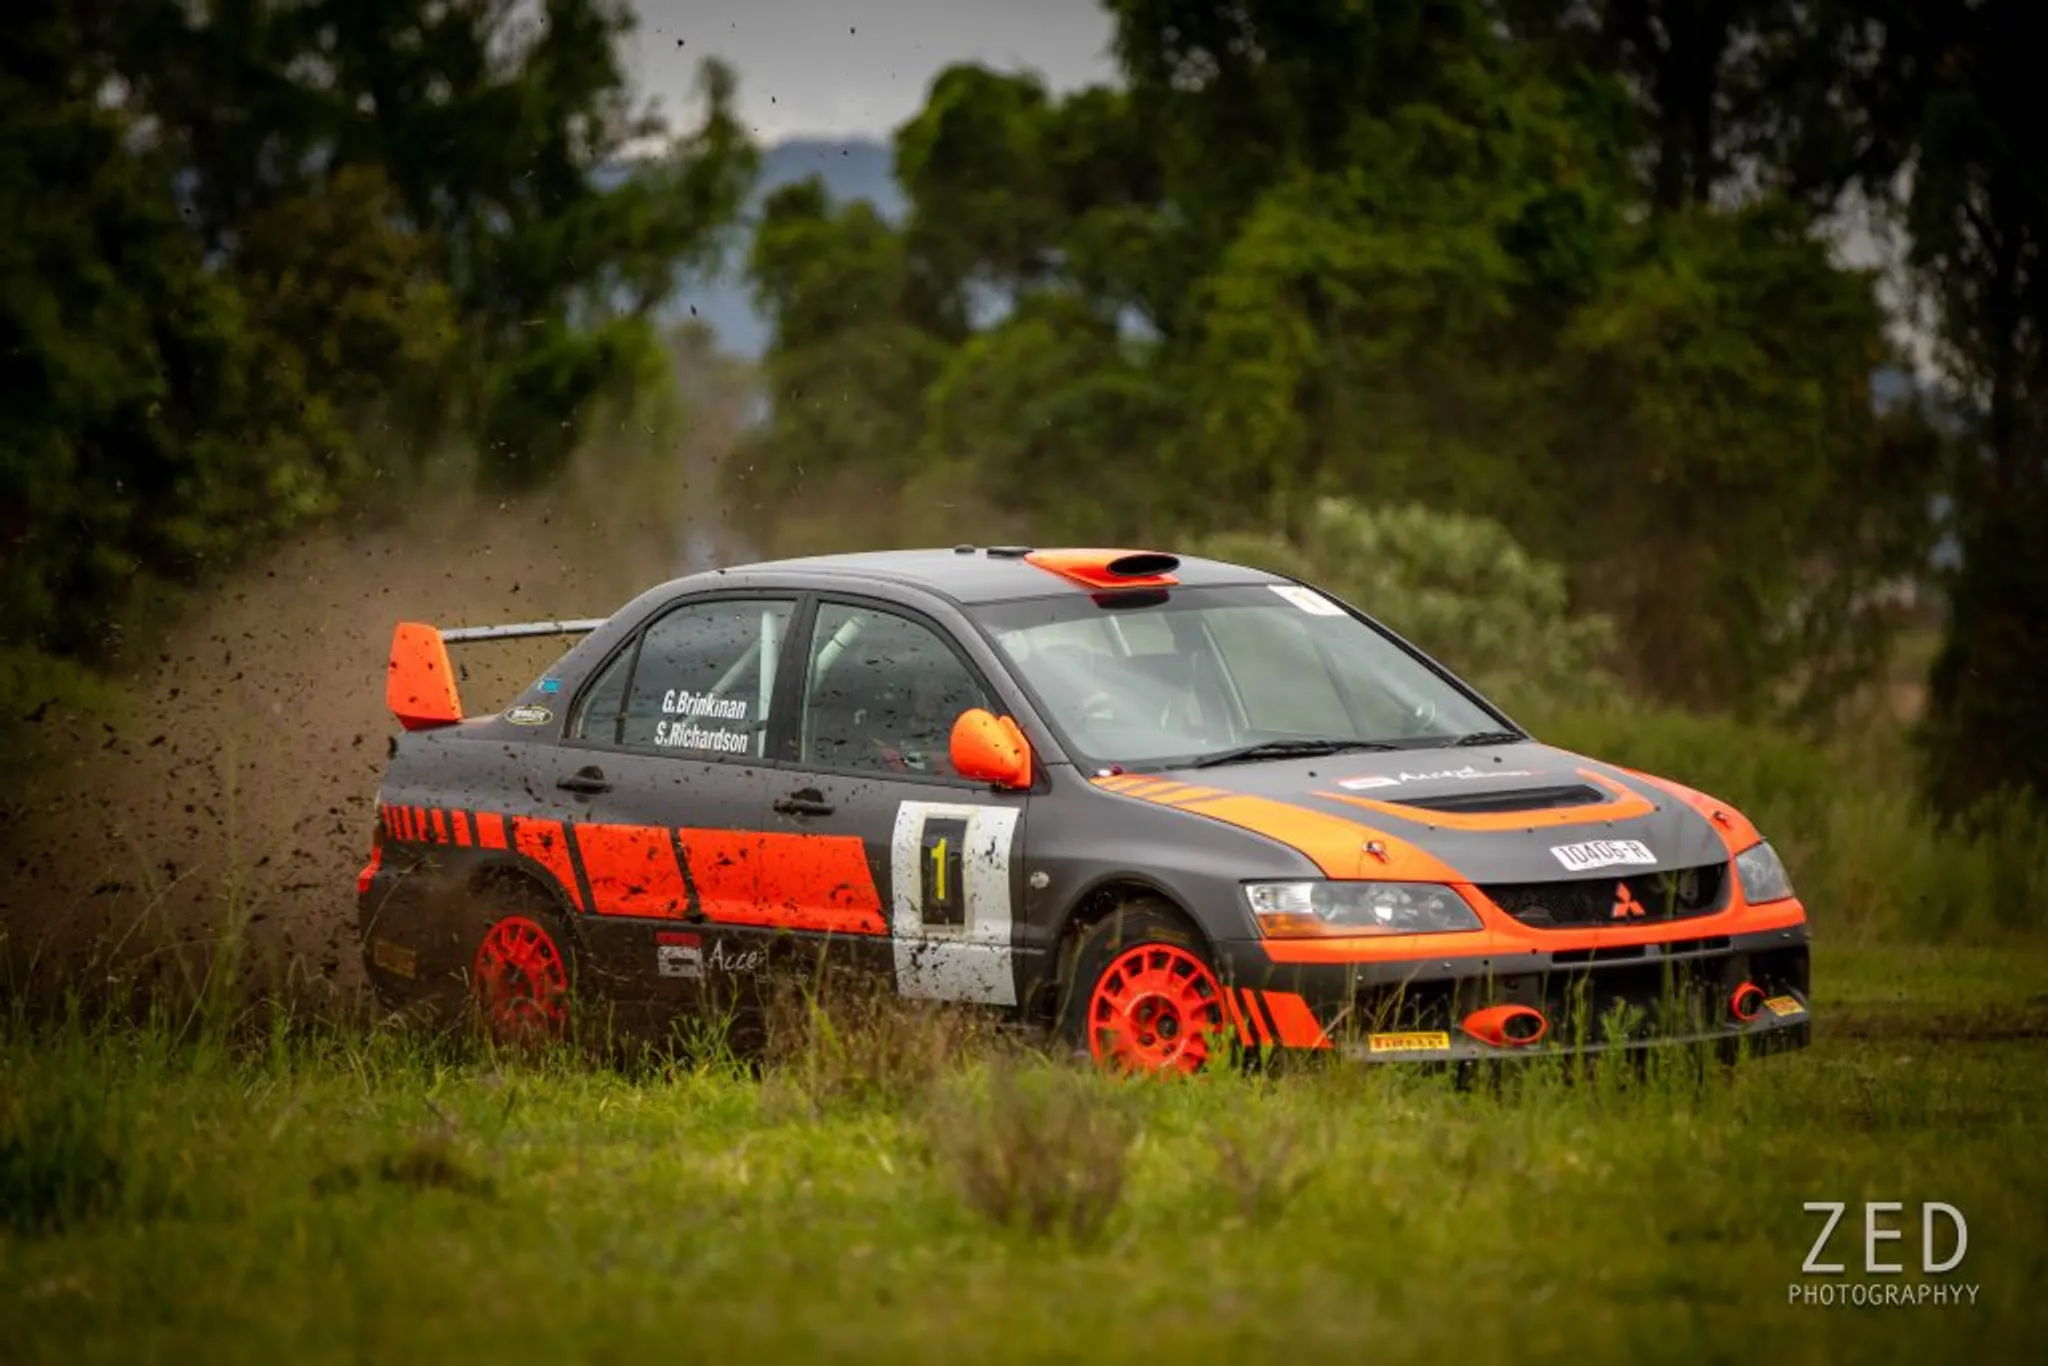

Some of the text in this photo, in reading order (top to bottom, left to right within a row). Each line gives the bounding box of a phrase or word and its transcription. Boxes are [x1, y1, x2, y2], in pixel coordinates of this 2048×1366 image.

[931, 837, 947, 900] 1
[1557, 840, 1648, 864] 10406-R
[709, 938, 766, 972] Acce
